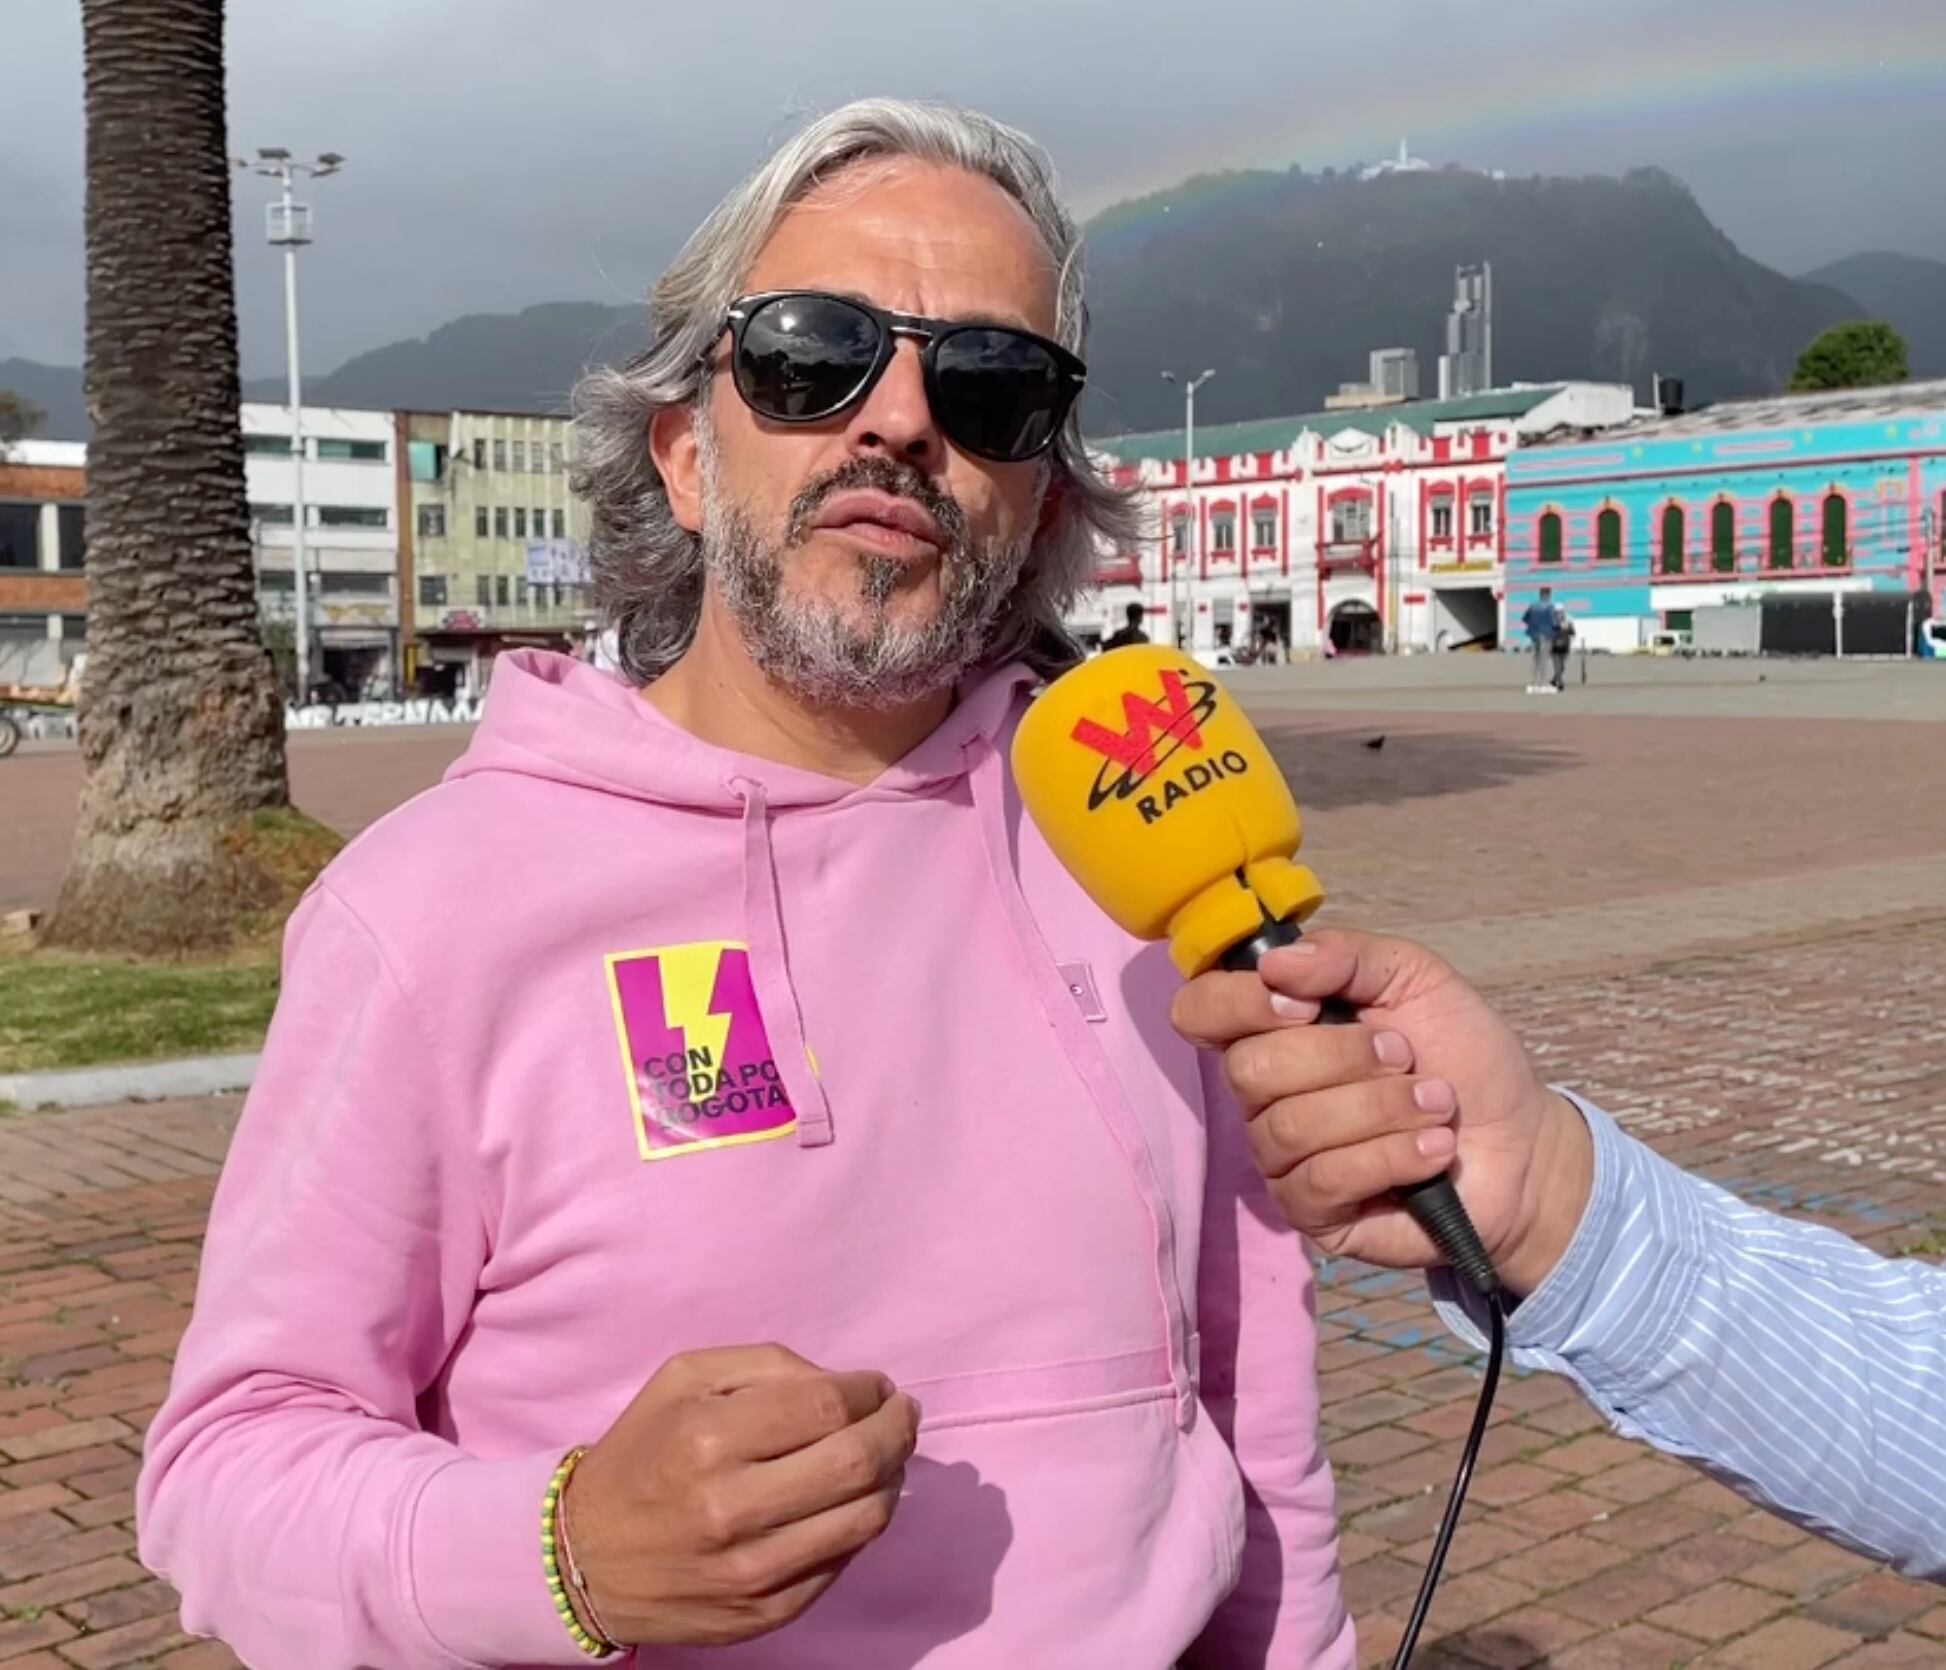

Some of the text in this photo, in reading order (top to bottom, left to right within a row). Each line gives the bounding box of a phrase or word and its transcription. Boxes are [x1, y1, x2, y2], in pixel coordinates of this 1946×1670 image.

[1070, 669, 1203, 776] W
[1136, 750, 1247, 824] RADIO
[644, 1046, 712, 1079] CON
[652, 1060, 779, 1105] TODA PO
